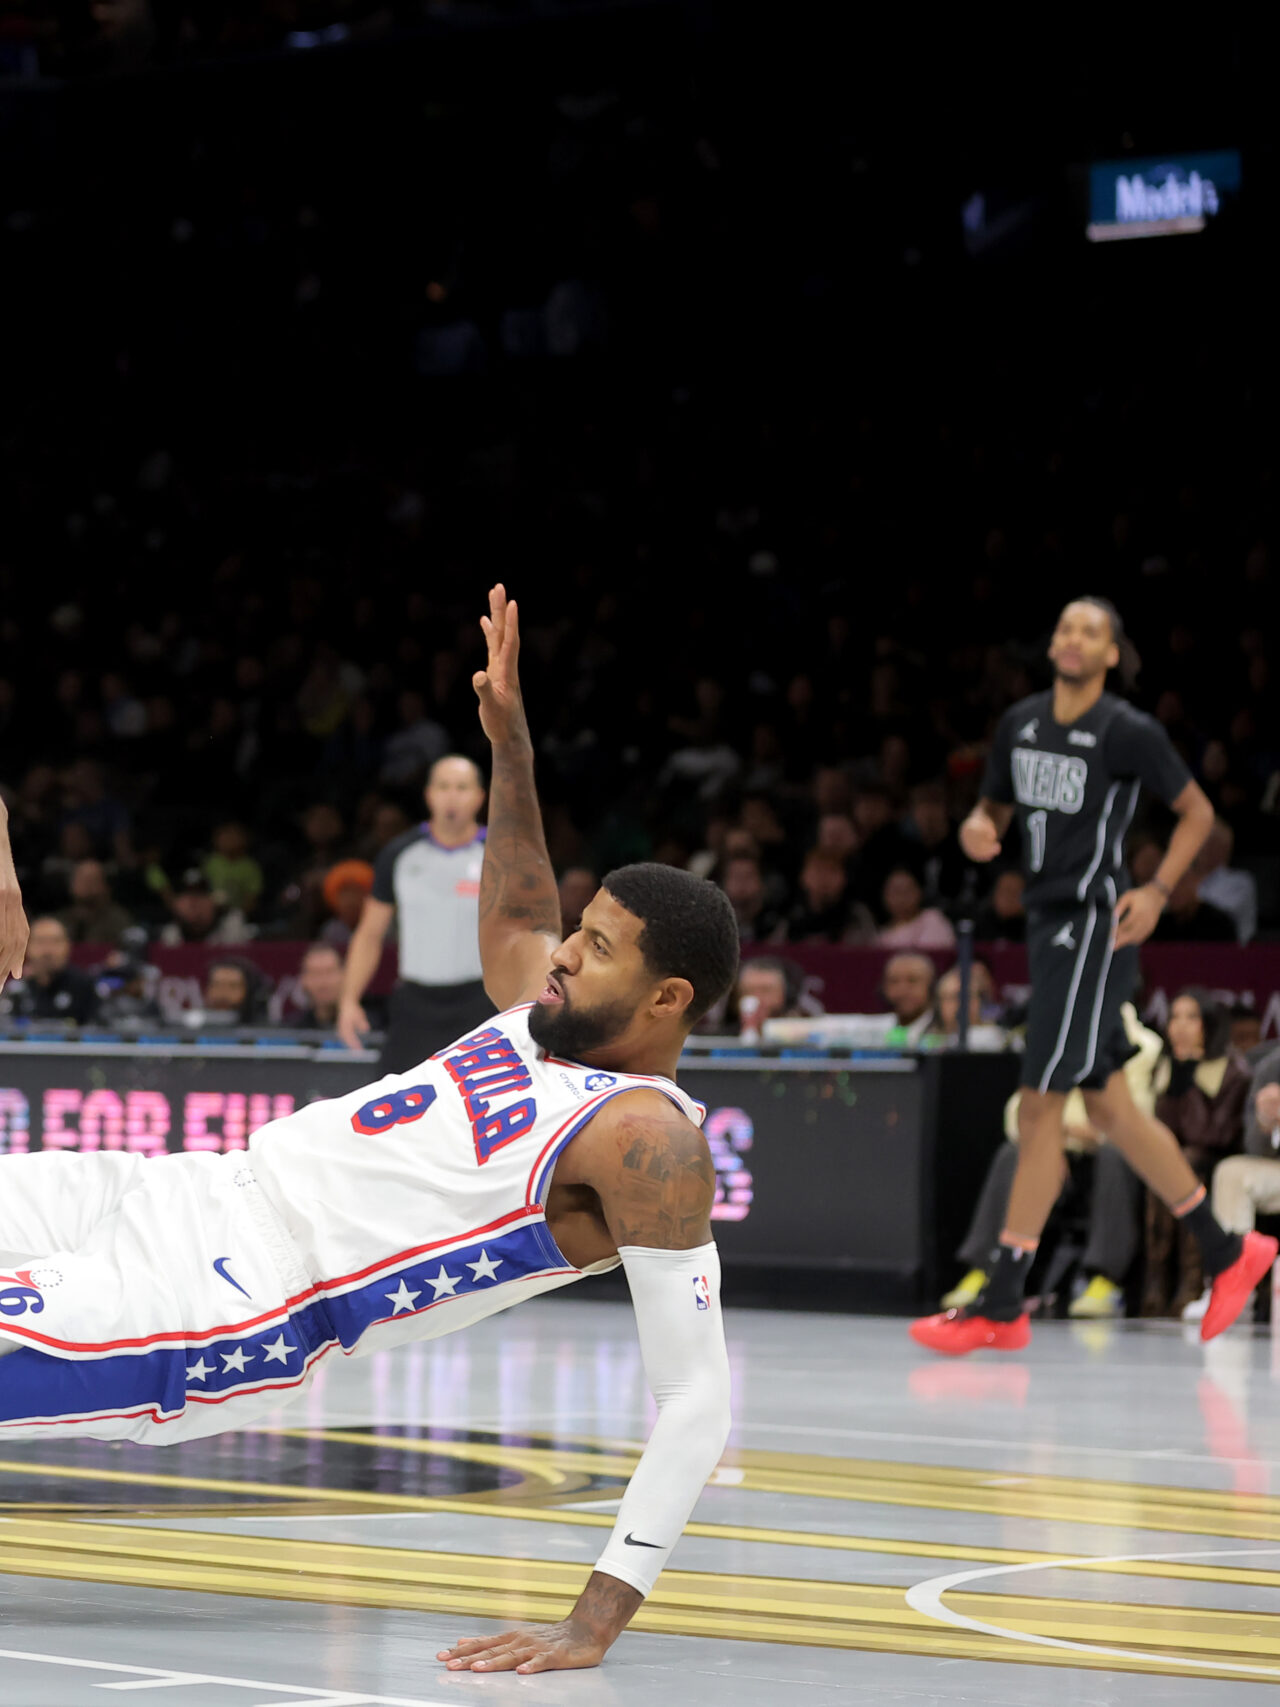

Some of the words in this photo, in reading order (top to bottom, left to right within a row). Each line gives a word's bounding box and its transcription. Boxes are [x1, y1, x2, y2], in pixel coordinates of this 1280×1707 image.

[1010, 747, 1088, 815] NETS
[1027, 809, 1048, 873] 1
[350, 1084, 438, 1136] 8
[428, 1026, 538, 1167] PHILA
